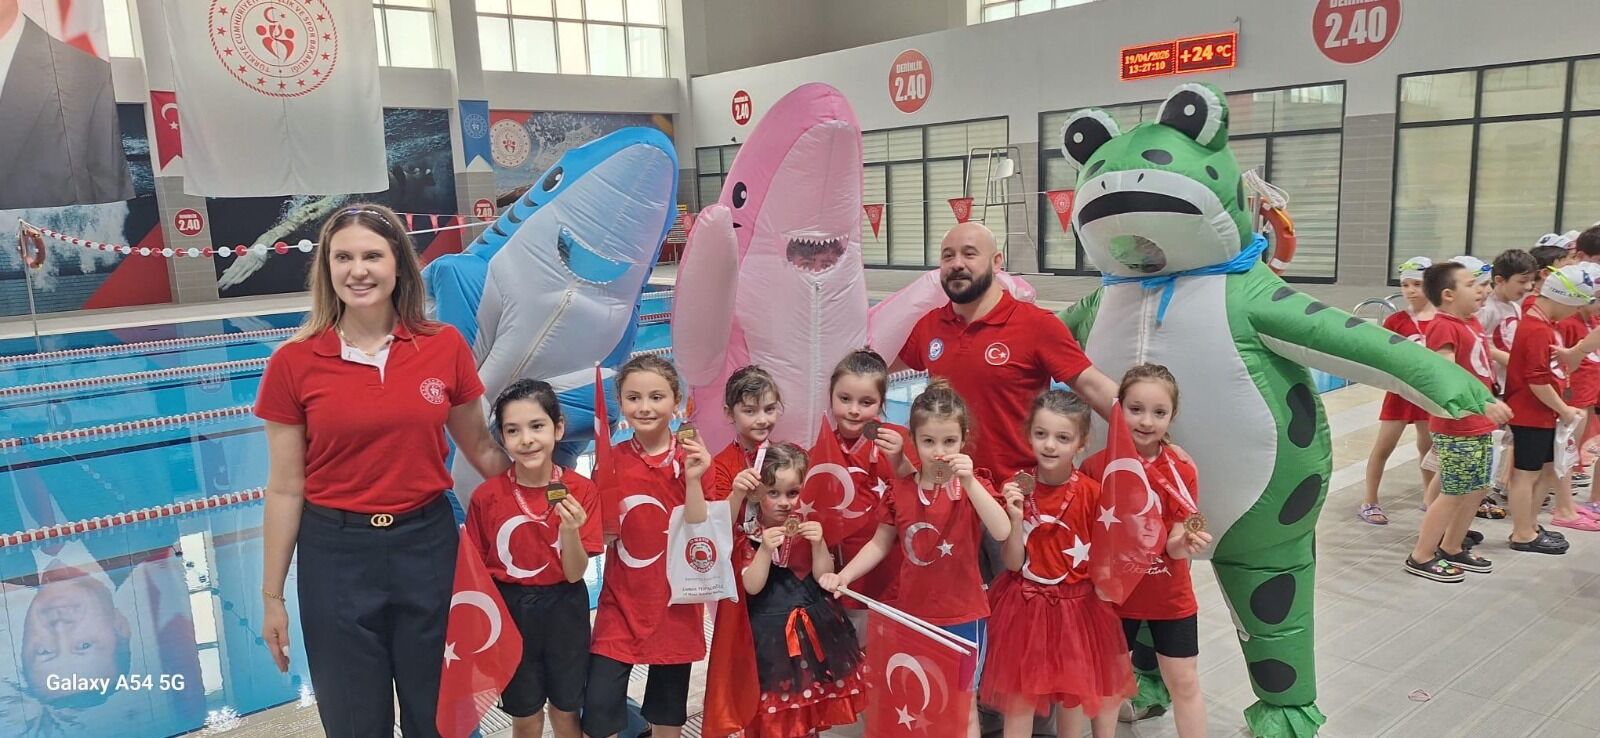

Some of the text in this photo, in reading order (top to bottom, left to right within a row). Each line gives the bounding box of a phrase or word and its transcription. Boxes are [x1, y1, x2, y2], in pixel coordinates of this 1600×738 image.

[296, 6, 305, 16] VE
[303, 16, 316, 38] SPOR
[1324, 6, 1387, 48] 2.40
[1129, 61, 1166, 74] 13:27:10
[895, 73, 926, 102] 2.40
[735, 103, 750, 120] 2.40
[178, 218, 201, 231] 2.40
